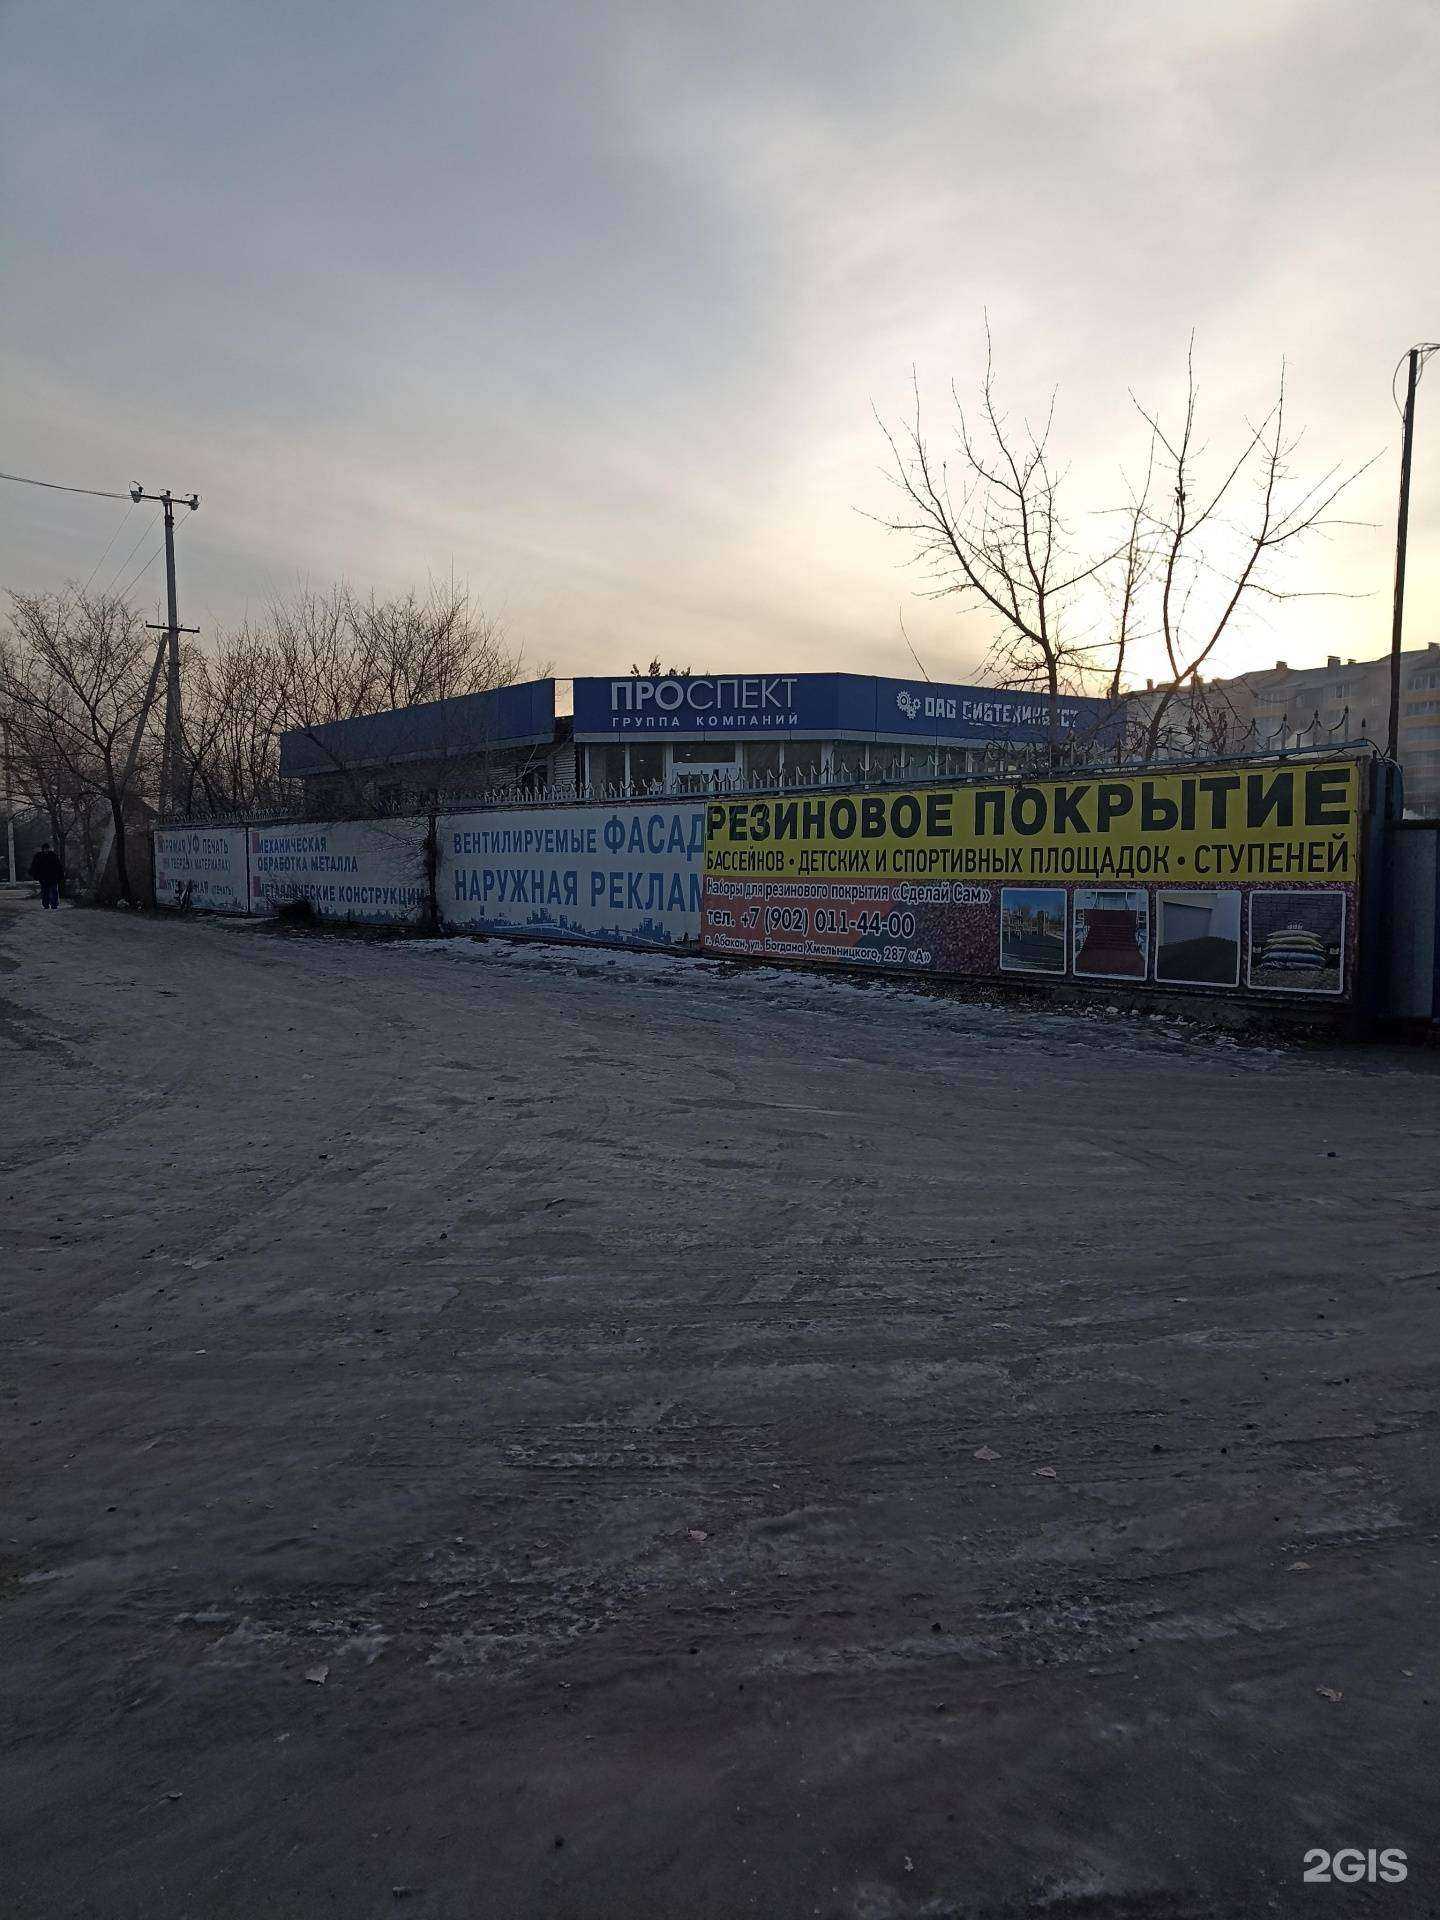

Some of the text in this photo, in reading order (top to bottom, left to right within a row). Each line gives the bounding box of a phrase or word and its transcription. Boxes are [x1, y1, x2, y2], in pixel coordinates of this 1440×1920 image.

[611, 678, 798, 711] ПРОСПЕКТ
[612, 713, 799, 728] ГРУППА КОМПАНИЙ
[706, 768, 1352, 841] РЕЗИНОВОЕ ПОКРЫТИЕ
[259, 837, 327, 853] МЕХАНИЧЕСКАЯ
[454, 828, 597, 854] ВЕНТИЛИРУЕМЫЕ
[706, 832, 1348, 879] БАССЕЙНОВ ДЕТСКИХ И СПОРТИВНЫХ ПЛОЩАДОК СТУПЕНЕЙ
[257, 856, 358, 873] ОБРАБОТКА МЕТАЛЛА
[454, 869, 578, 906] НАРУЖНАЯ
[707, 878, 991, 904] Наборы для резинового покрытия «Сделай Сам»
[707, 906, 915, 938] тел. +7 (902) 011-44-00
[714, 934, 748, 950] Абакан,
[749, 940, 762, 952] ул.
[765, 939, 805, 956] Богдана
[806, 942, 881, 962] Хмельницкого,
[884, 946, 906, 962] 287
[908, 948, 931, 964] «А»
